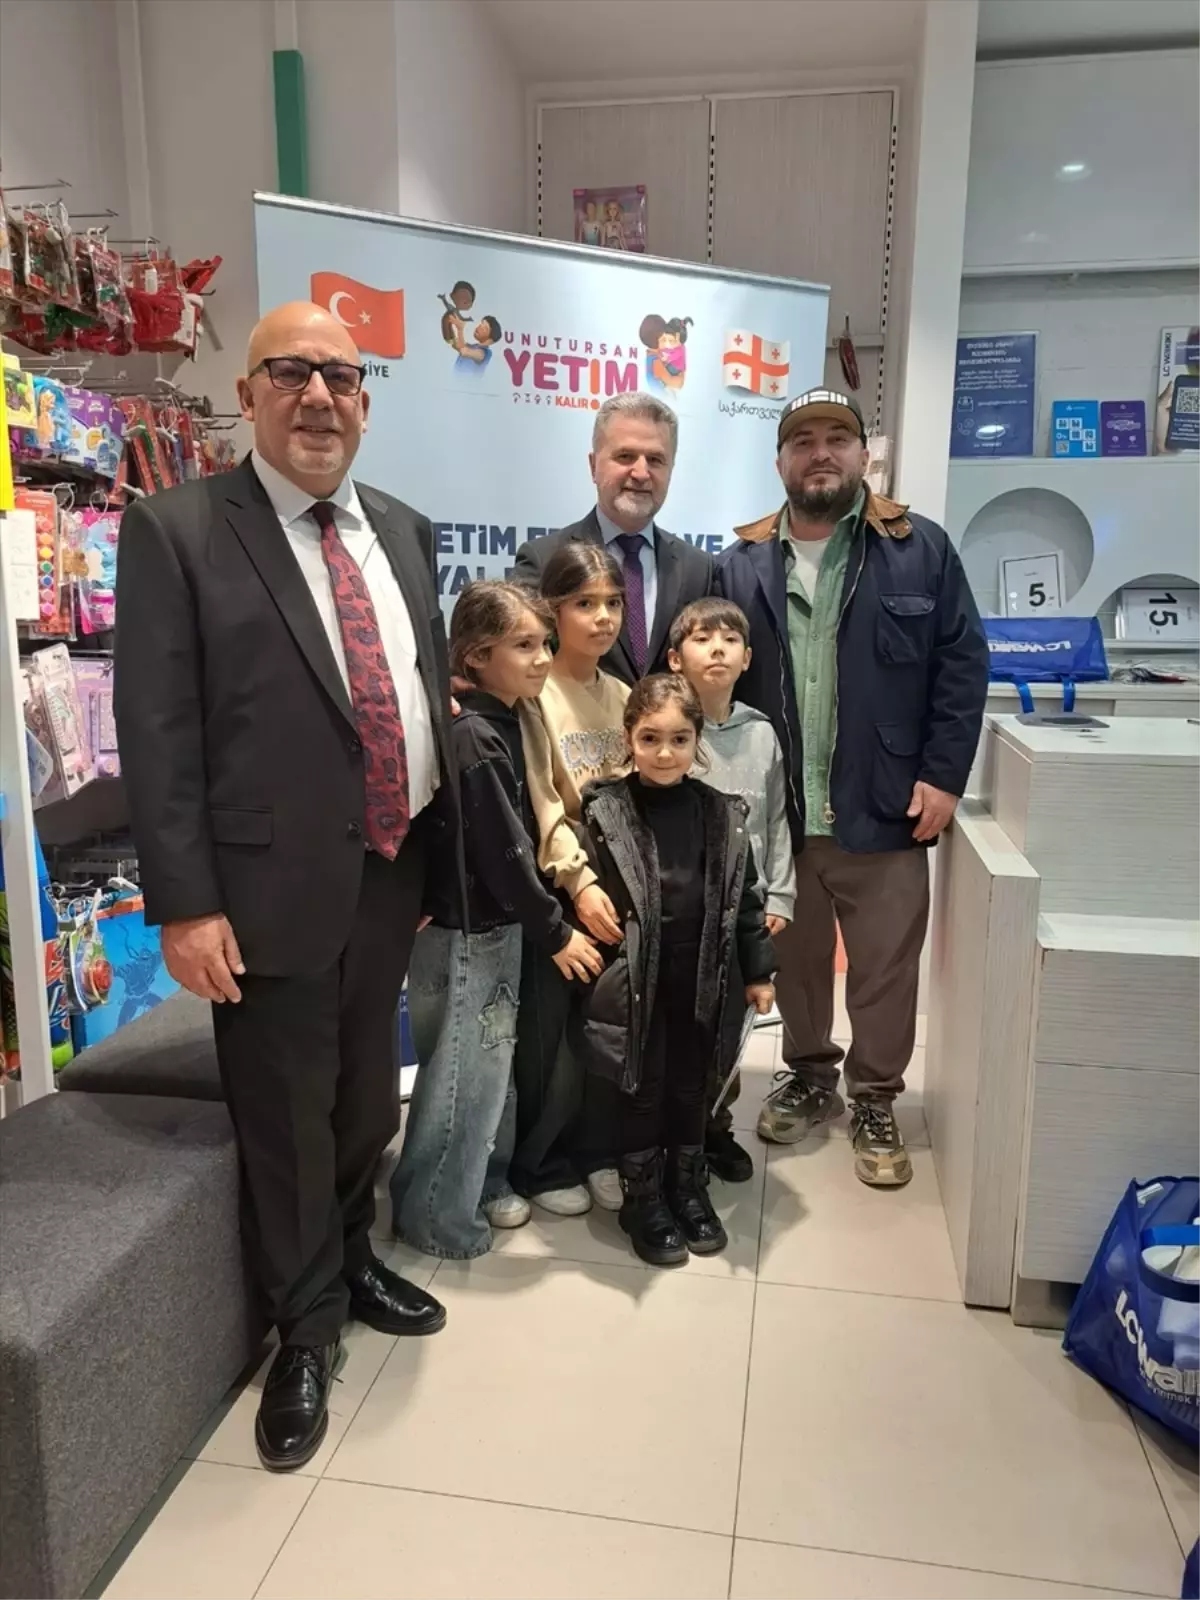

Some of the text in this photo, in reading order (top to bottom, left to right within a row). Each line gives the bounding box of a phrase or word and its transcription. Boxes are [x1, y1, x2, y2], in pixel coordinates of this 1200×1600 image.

[504, 331, 638, 360] UNUTURSAN
[555, 395, 588, 409] KALIR
[1028, 581, 1047, 607] 5
[1149, 592, 1178, 628] 15
